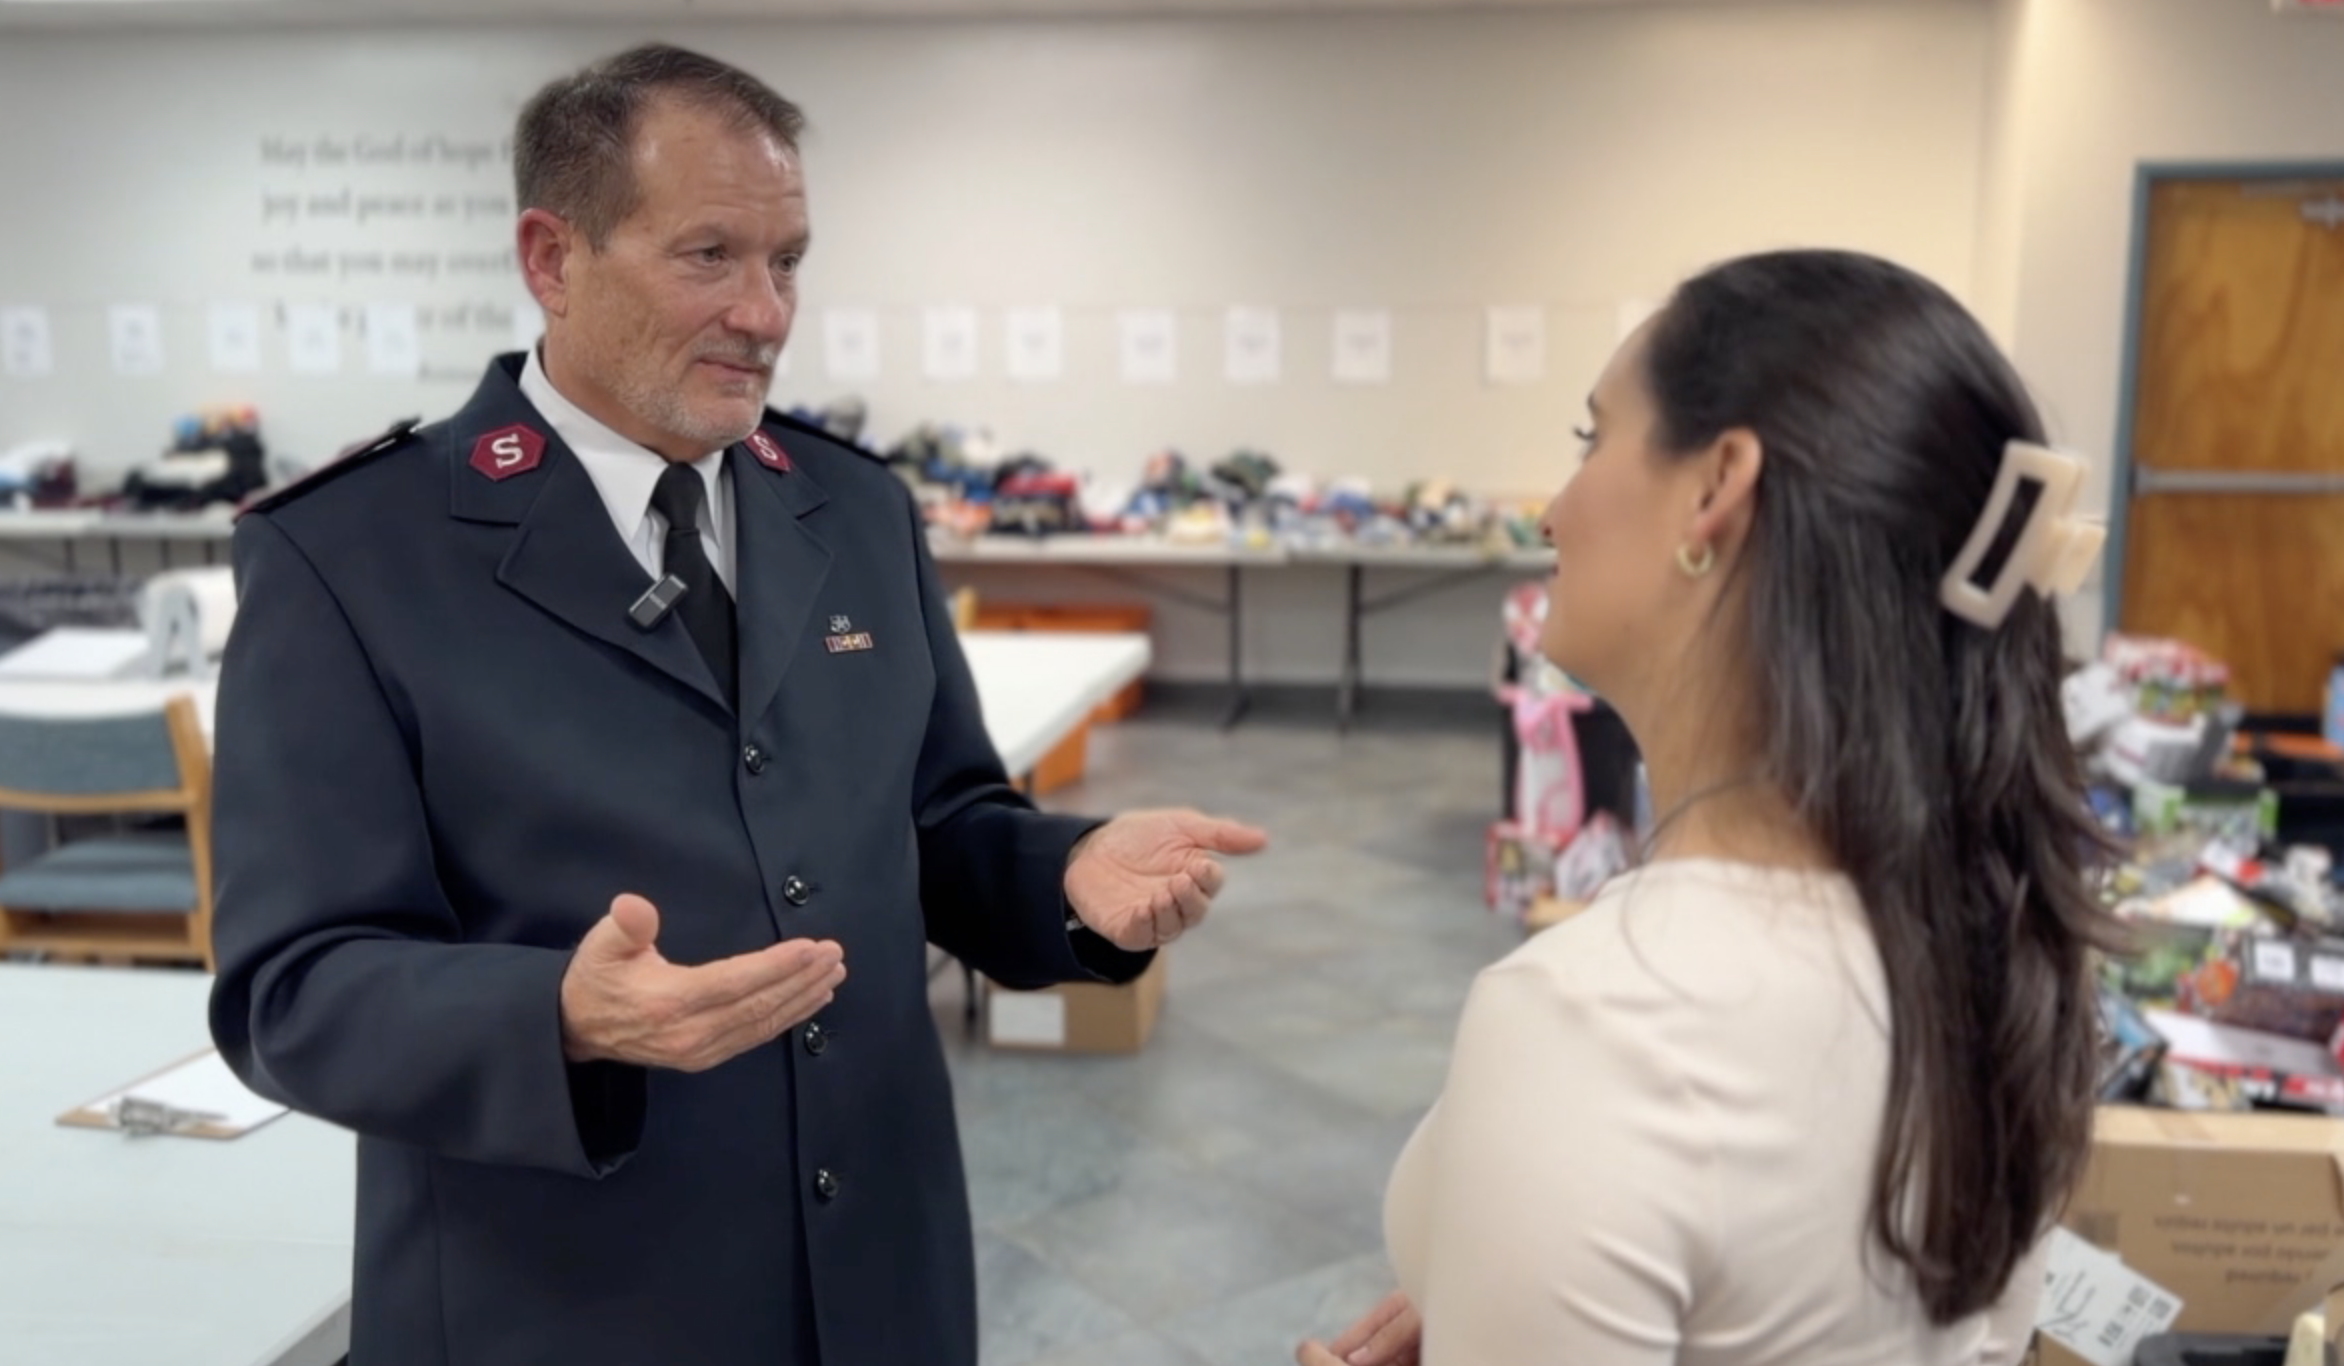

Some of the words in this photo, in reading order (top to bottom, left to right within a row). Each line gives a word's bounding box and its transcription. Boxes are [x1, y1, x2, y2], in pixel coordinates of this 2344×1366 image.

[261, 137, 305, 173] May
[314, 136, 347, 163] the
[354, 136, 403, 163] God
[410, 136, 437, 163] of
[439, 136, 492, 172] hope
[262, 187, 298, 224] joy
[308, 187, 350, 216] and
[357, 195, 424, 225] peace
[434, 195, 455, 216] as
[464, 195, 509, 225] you
[283, 244, 329, 273] that
[340, 252, 383, 281] you
[392, 252, 438, 282] may
[442, 302, 469, 331] of
[475, 301, 514, 331] the
[491, 433, 523, 468] S
[753, 433, 777, 462] S
